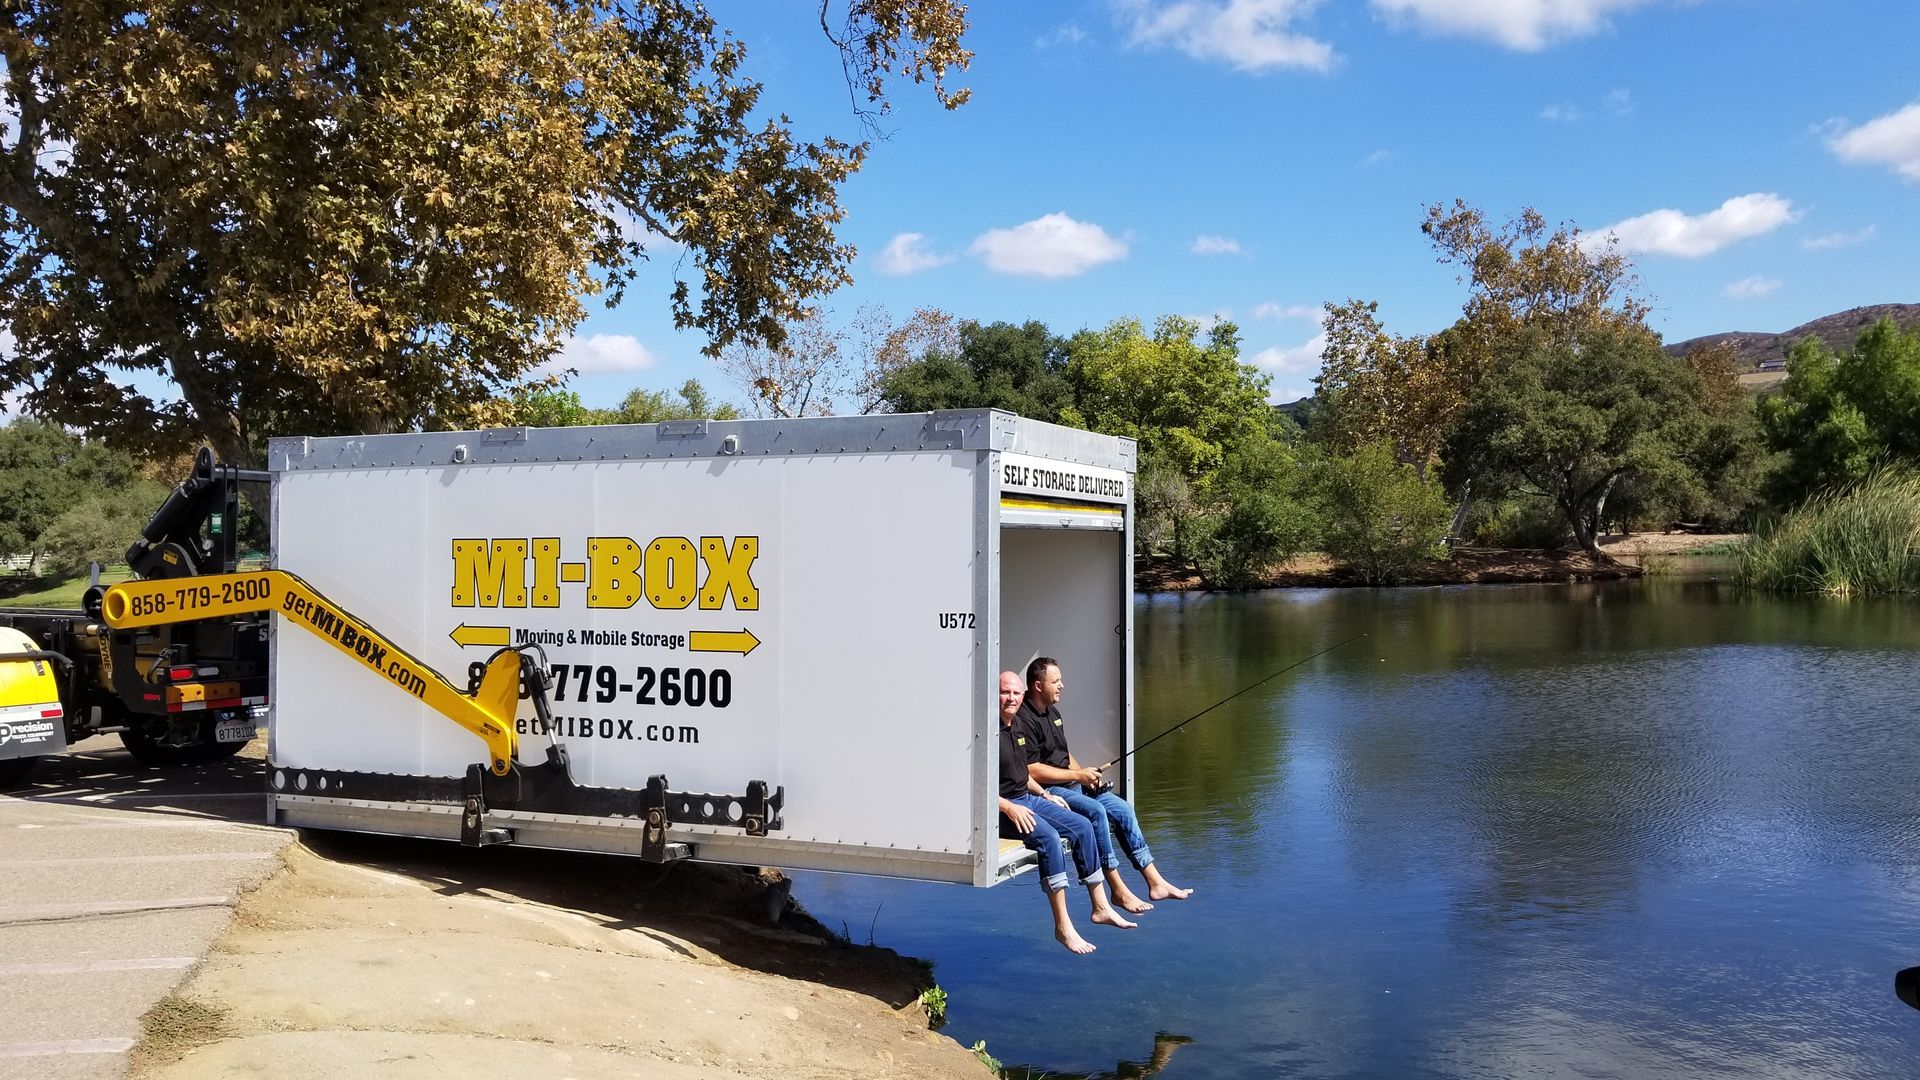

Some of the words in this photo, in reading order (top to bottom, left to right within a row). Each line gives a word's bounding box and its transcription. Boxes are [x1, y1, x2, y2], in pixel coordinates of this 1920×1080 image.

[1004, 464, 1030, 486] SELF
[1032, 467, 1076, 492] STORAGE
[1078, 475, 1124, 498] DELIVERED
[452, 536, 759, 611] MI-BOX
[131, 577, 271, 618] 858-779-2600
[515, 628, 564, 648] Moving
[566, 629, 577, 644] &
[581, 630, 627, 646] Mobile
[631, 631, 685, 650] Storage
[939, 612, 976, 629] U572
[282, 590, 428, 699] getMIBOX.com
[468, 661, 731, 708] 8779-2600
[515, 716, 700, 744] etIBOX.com
